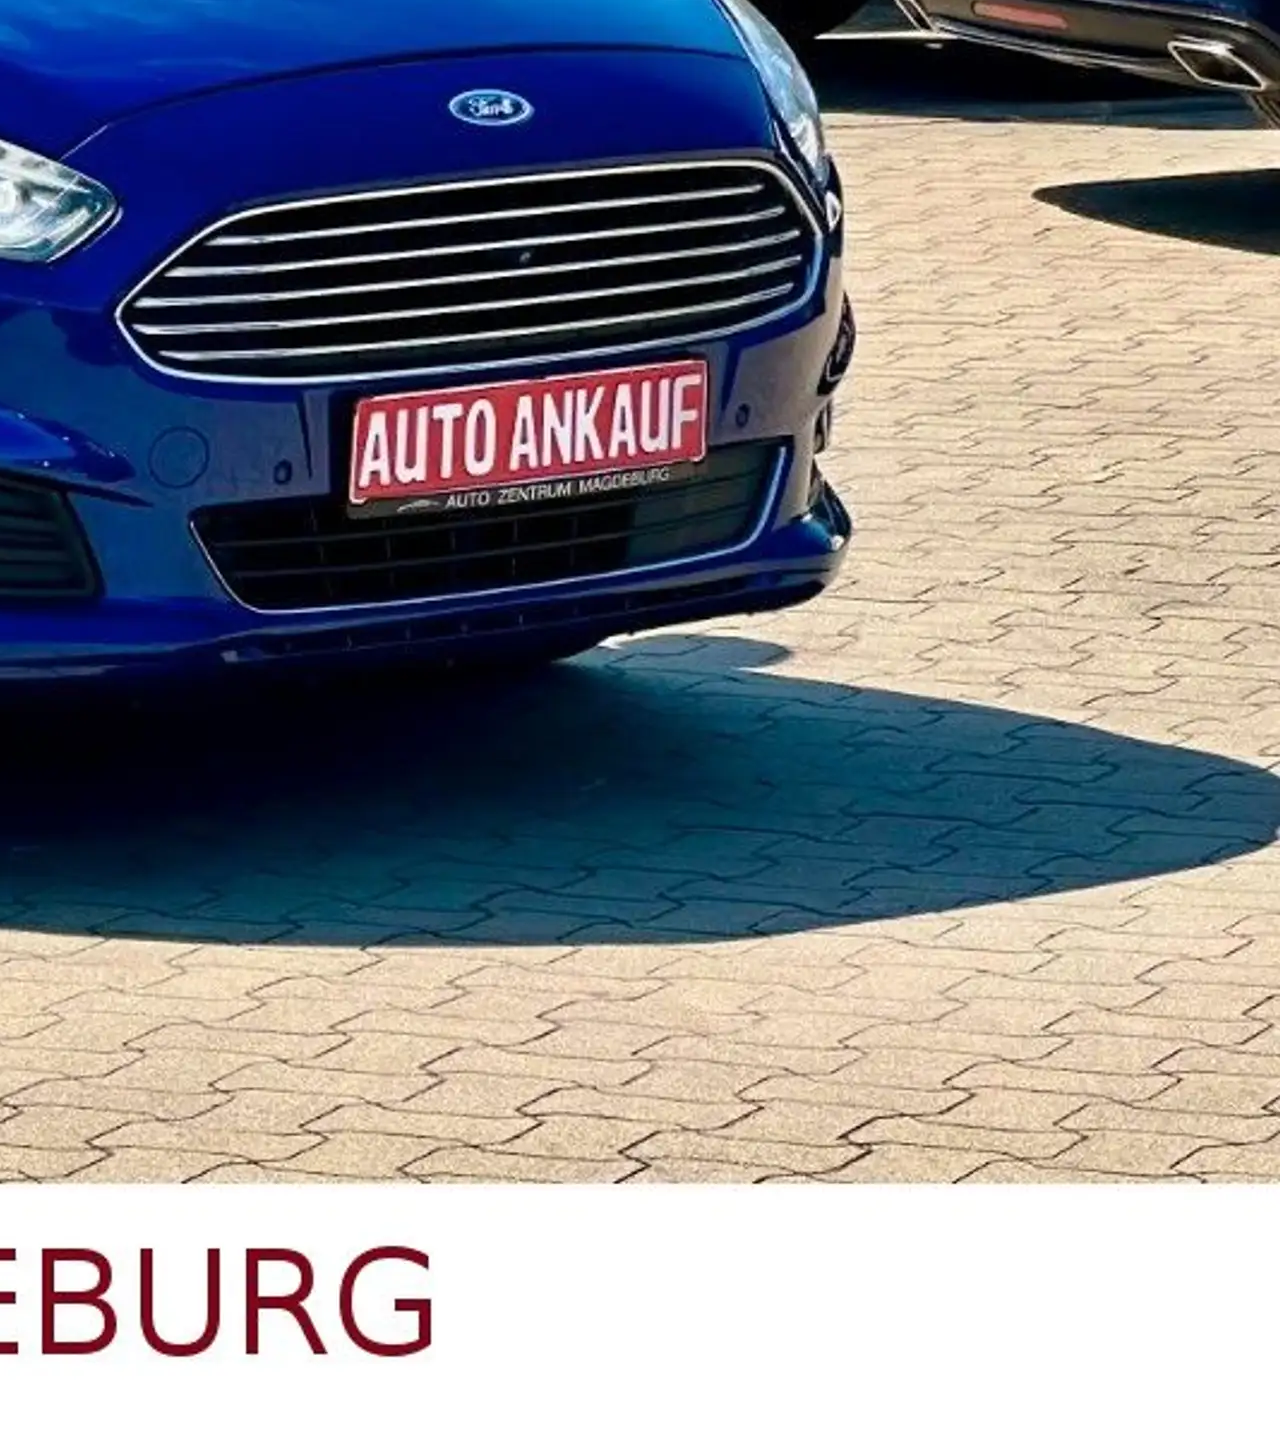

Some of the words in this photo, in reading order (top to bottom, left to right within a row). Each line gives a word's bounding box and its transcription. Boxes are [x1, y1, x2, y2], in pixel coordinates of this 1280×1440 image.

[358, 398, 497, 488] AUTO
[509, 373, 702, 471] ANKAUF
[445, 491, 491, 510] AUTO
[497, 479, 572, 506] ZENTRUM
[578, 467, 671, 495] MAGDEBURG
